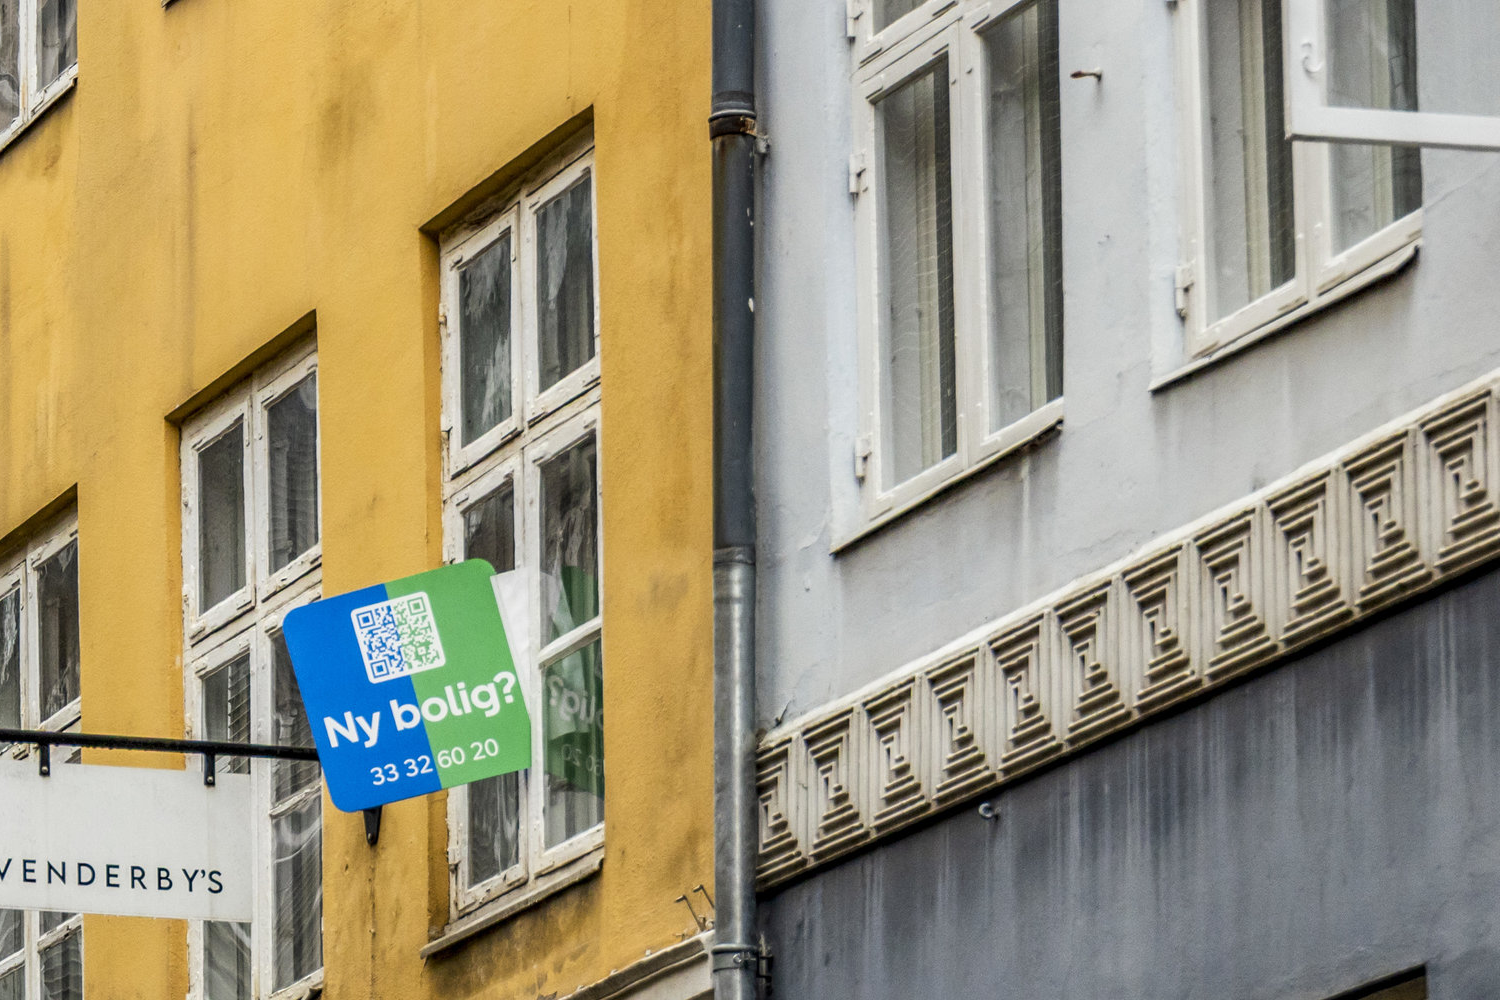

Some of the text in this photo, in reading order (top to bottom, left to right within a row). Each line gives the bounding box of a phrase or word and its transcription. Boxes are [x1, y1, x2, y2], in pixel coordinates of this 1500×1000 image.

[323, 671, 516, 748] Ny bolig?
[370, 738, 499, 786] 33 32 60 20
